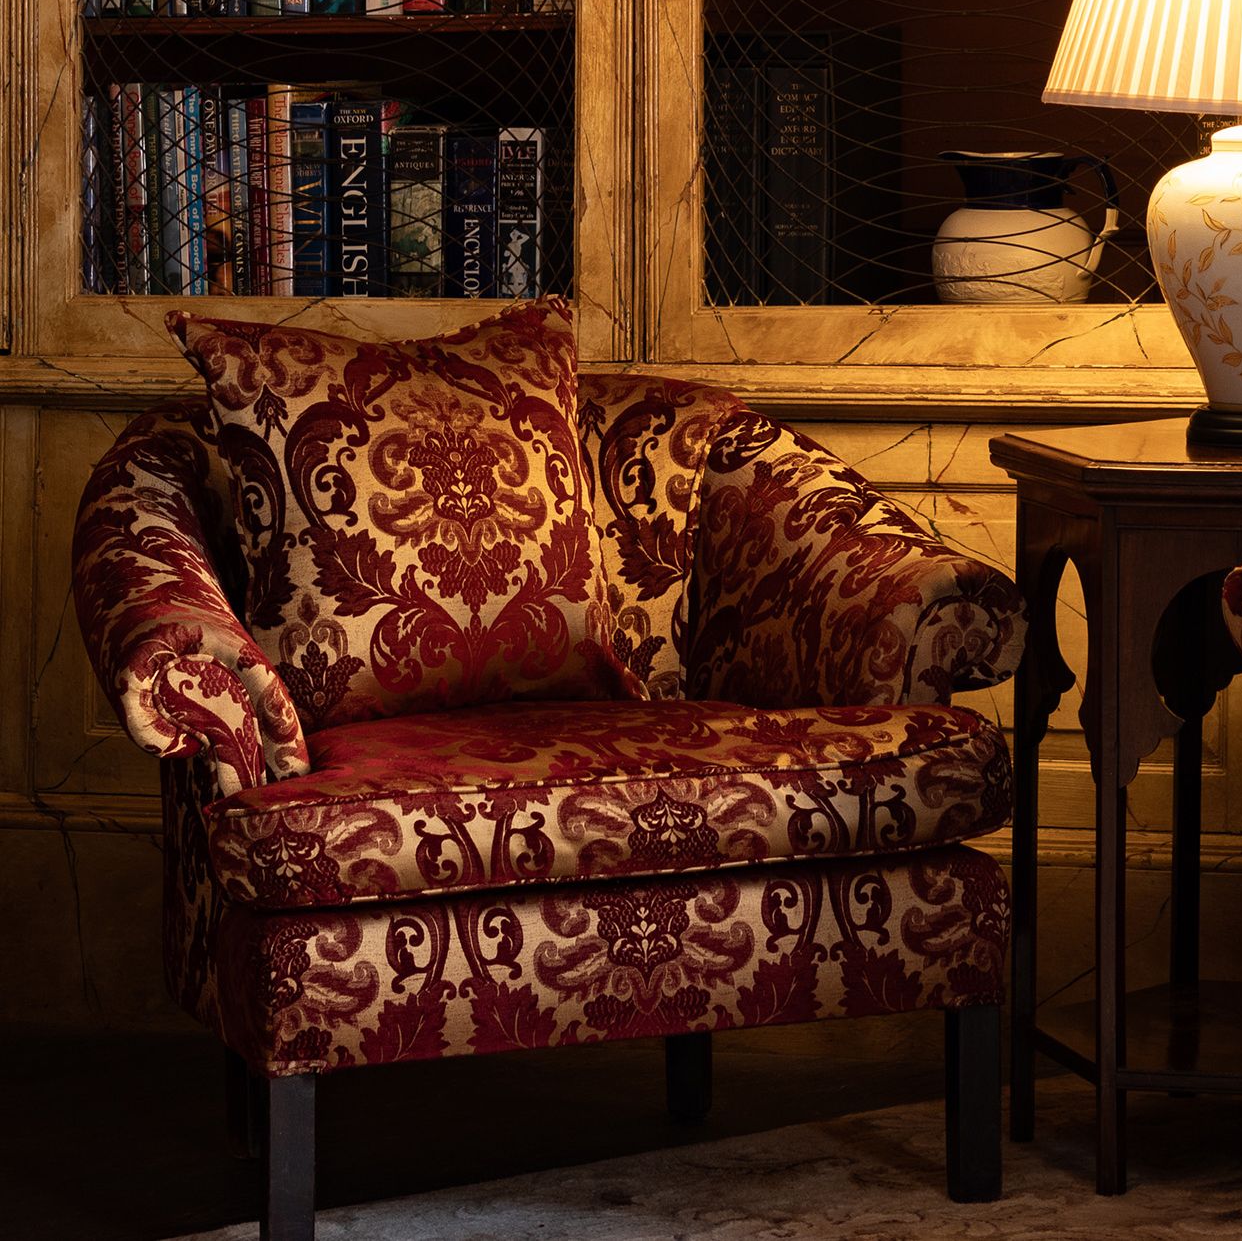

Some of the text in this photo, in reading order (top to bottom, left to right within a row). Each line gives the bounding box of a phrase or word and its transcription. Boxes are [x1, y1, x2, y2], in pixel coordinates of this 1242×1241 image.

[275, 97, 286, 118] The
[334, 114, 374, 124] OXFORD
[394, 161, 435, 170] ANTIQUES
[340, 136, 369, 297] ENGLISH
[276, 202, 290, 264] Chronicles
